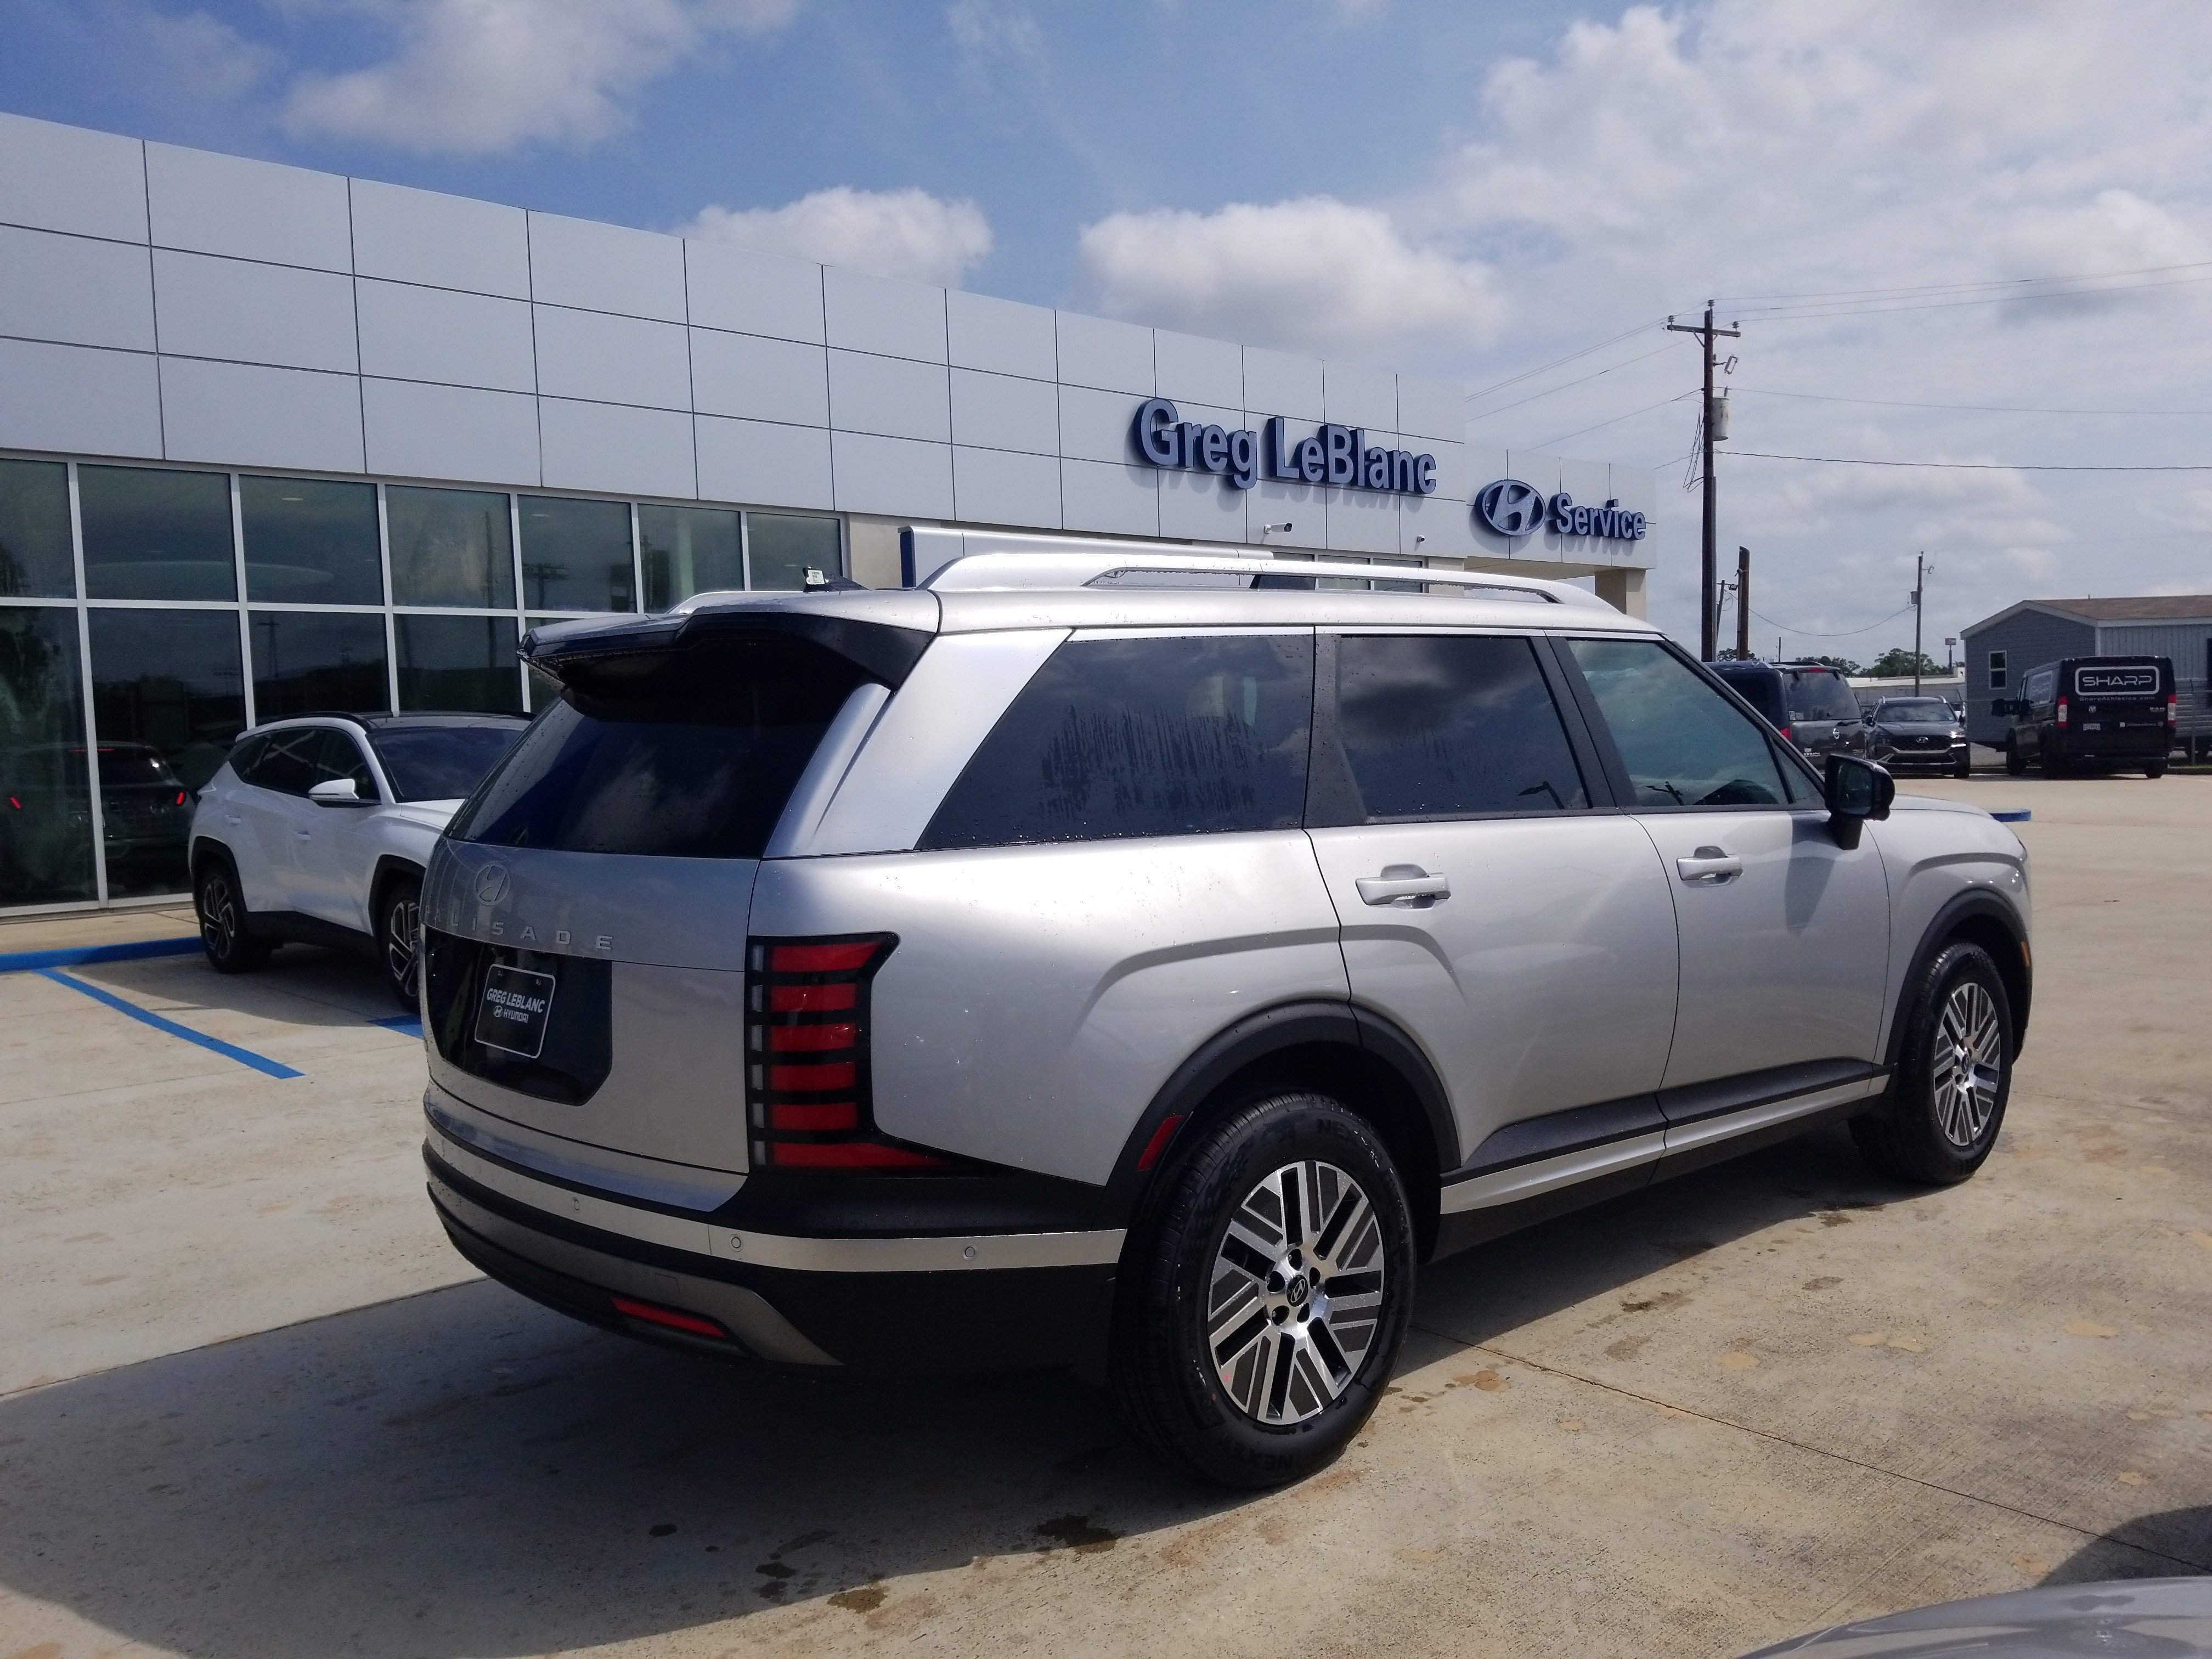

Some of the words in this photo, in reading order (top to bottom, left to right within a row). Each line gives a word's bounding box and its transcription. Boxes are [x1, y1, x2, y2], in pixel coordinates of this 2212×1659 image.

[1136, 397, 1257, 489] Greg
[1268, 416, 1437, 494] LeBlanc
[1555, 493, 1646, 540] Service
[2083, 675, 2152, 686] SHARP
[487, 988, 507, 1004] GREG
[506, 992, 545, 1013] LEBLANC
[504, 1009, 529, 1023] HYUNDAI
